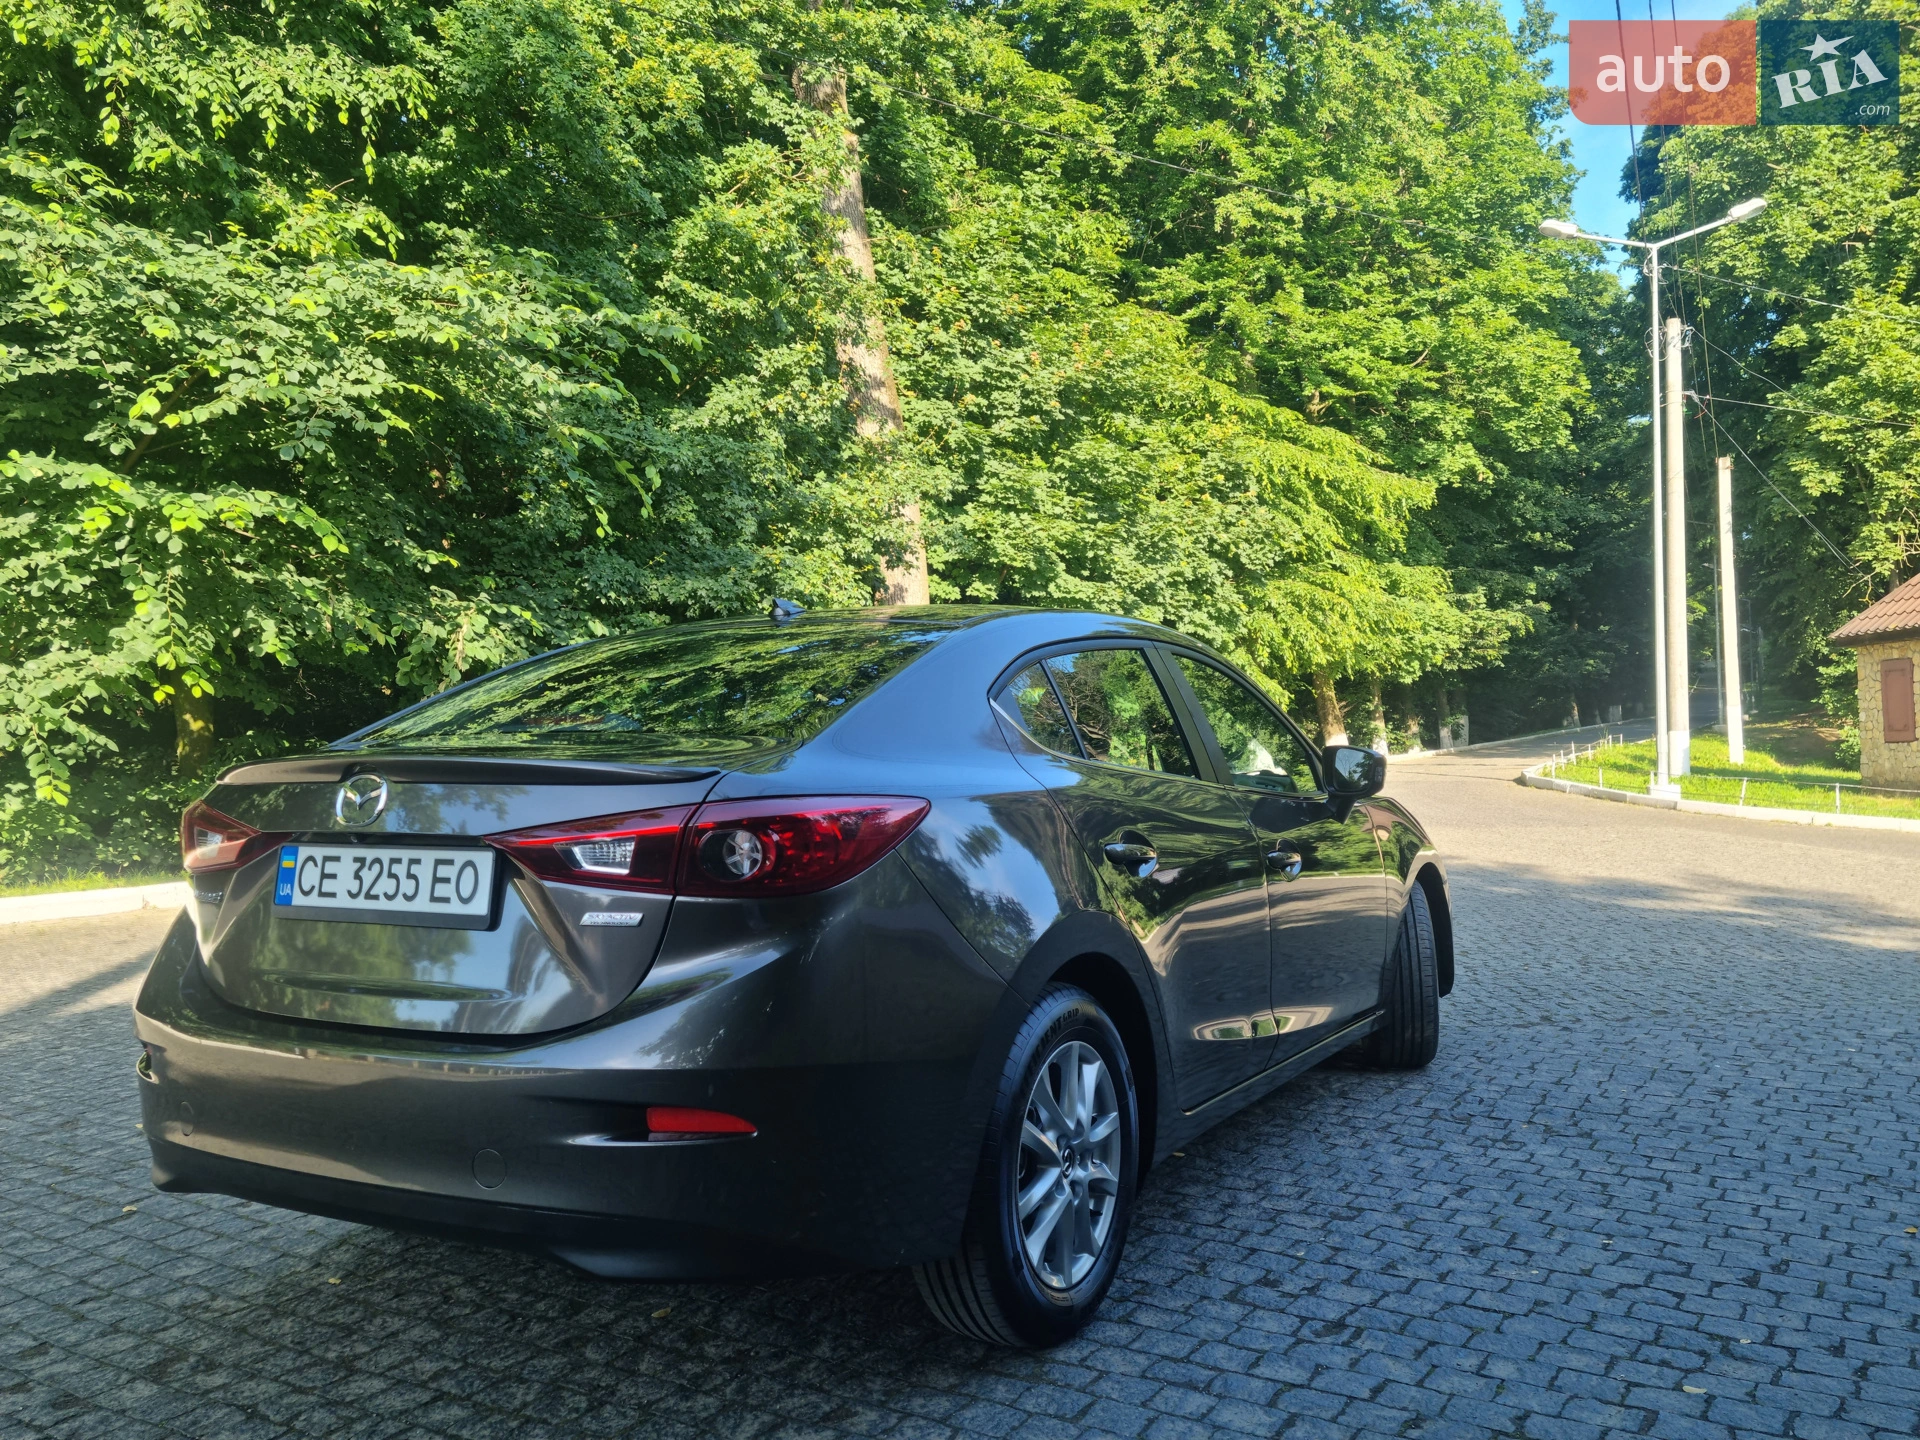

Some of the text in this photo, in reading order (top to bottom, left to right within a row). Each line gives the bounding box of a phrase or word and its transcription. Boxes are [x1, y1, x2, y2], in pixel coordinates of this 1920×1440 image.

[279, 883, 292, 896] UA
[298, 855, 479, 905] CE 3255 EO
